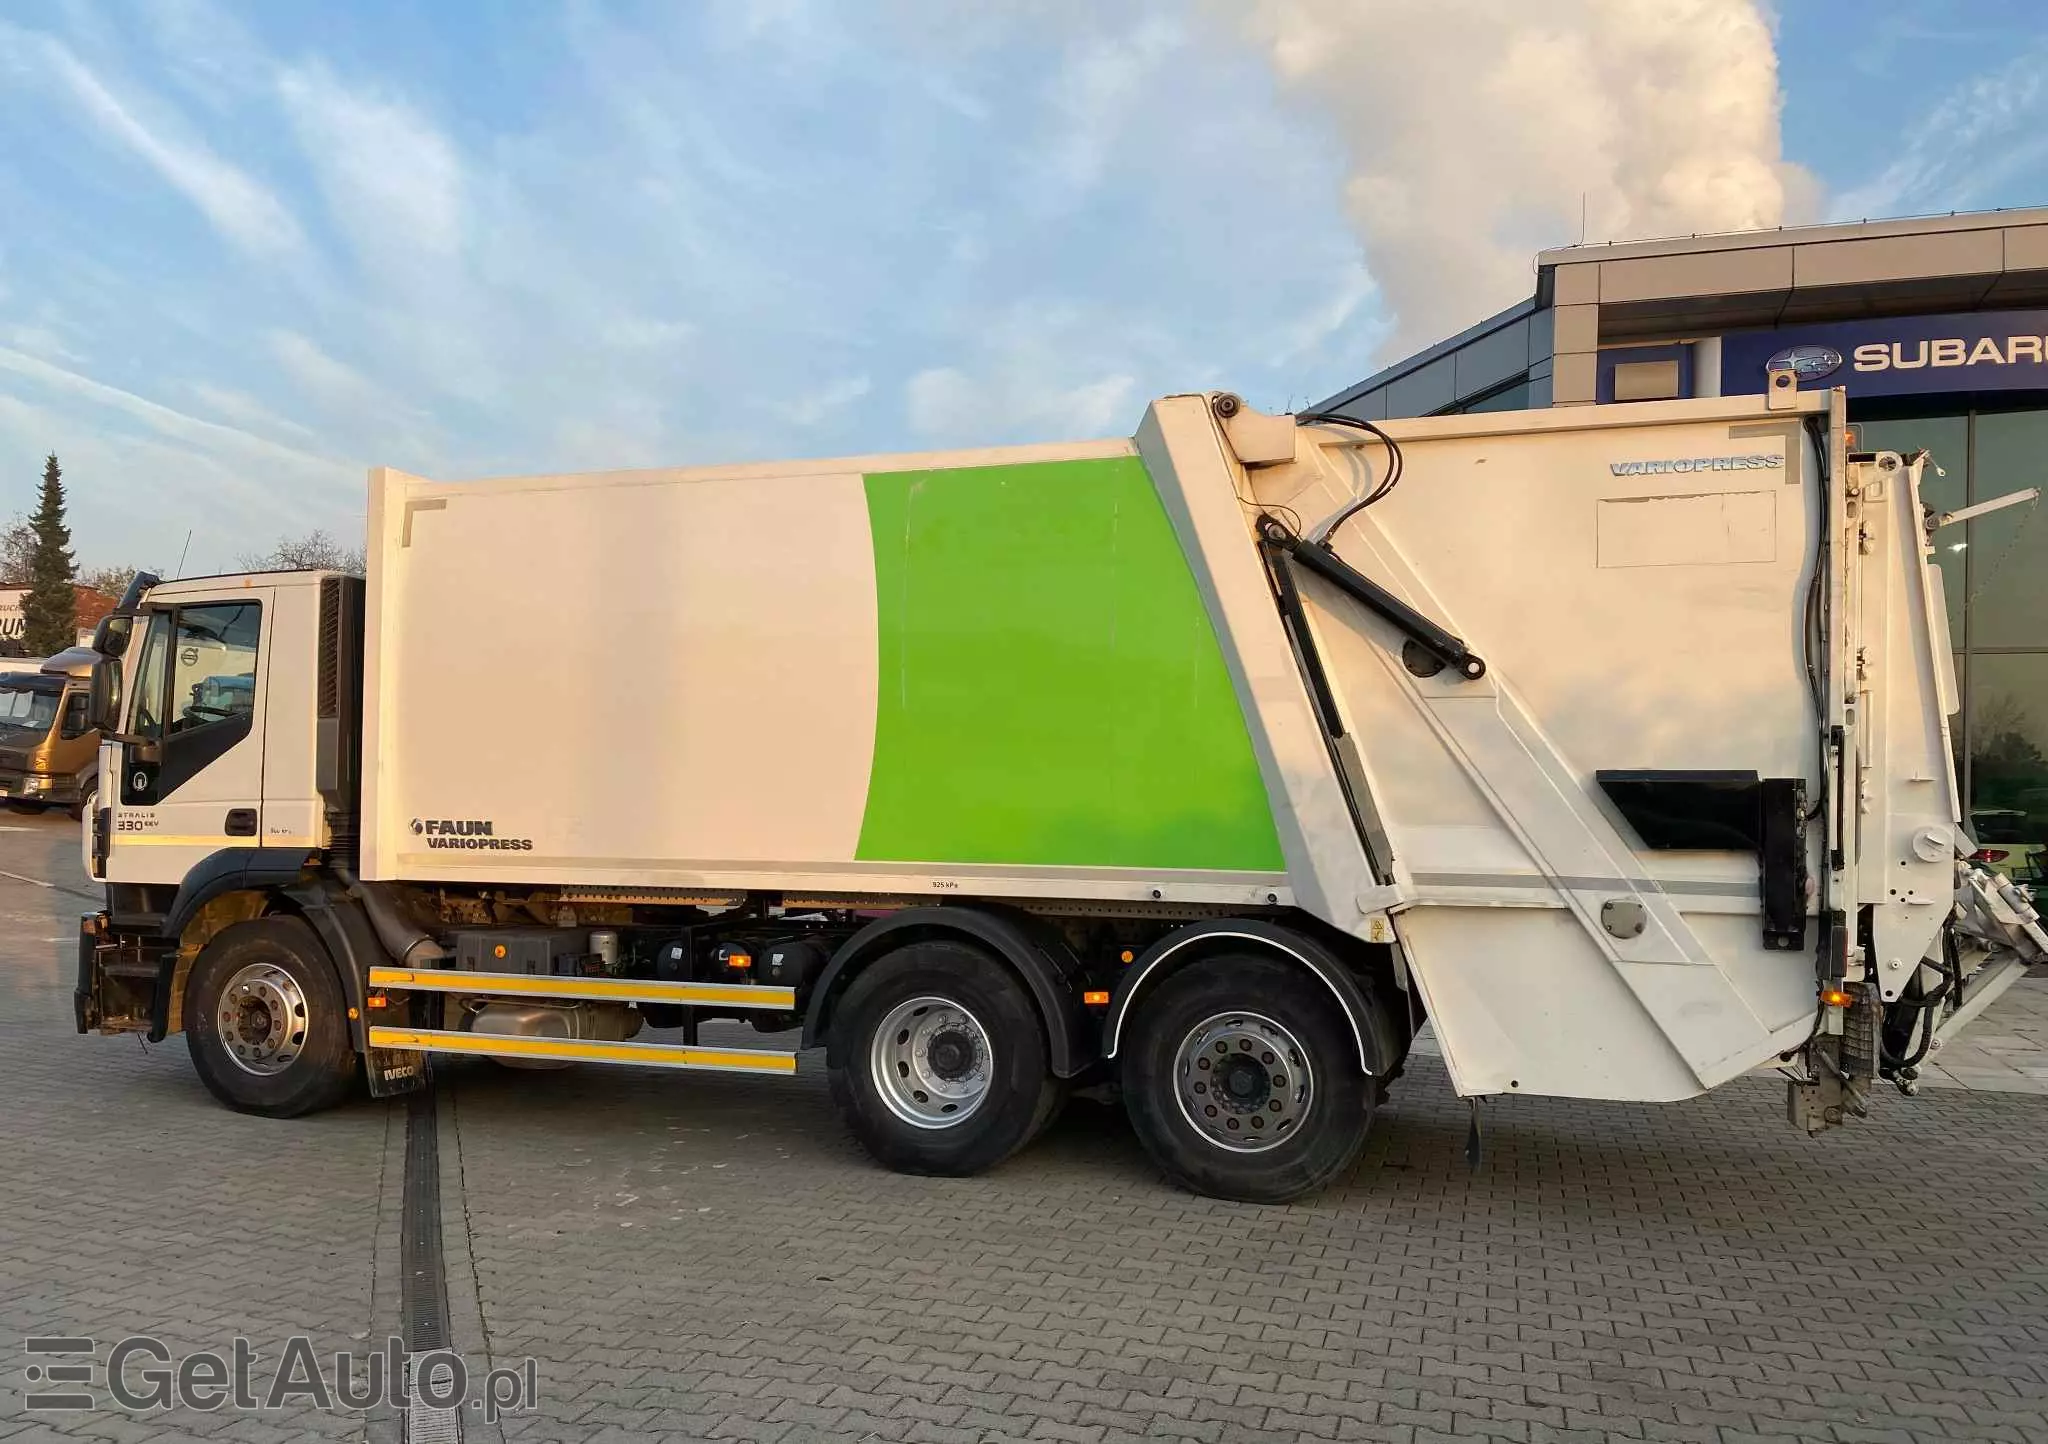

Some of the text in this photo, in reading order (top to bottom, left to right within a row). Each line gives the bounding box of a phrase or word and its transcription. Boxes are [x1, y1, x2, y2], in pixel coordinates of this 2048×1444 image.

[1854, 335, 2048, 372] SUBAR
[1610, 455, 1784, 477] VARIOPRESS
[118, 820, 143, 831] 330
[425, 820, 493, 836] FAUN
[427, 837, 533, 850] VARIOPRESS
[384, 1065, 413, 1081] IVECO
